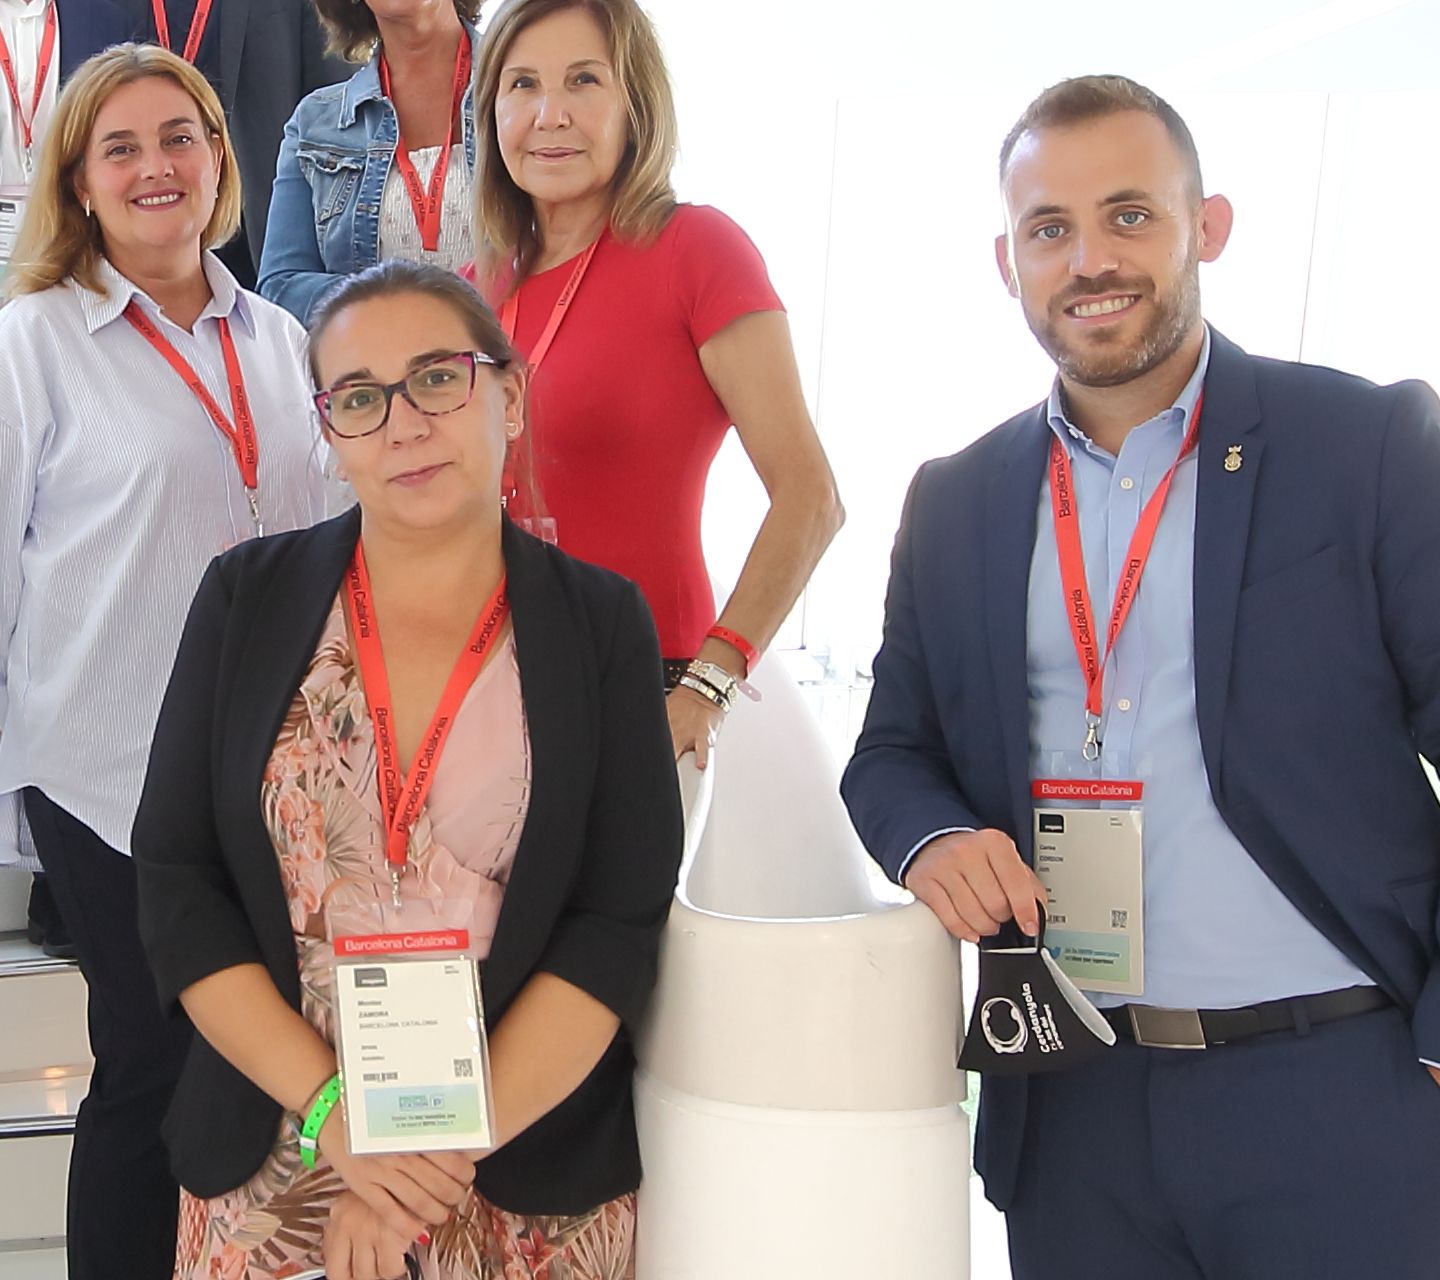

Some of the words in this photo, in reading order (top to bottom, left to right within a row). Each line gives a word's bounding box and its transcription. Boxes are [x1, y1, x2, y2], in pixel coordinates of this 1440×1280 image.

[242, 422, 255, 465] Barcelona
[1058, 459, 1071, 518] Barcelona
[350, 589, 370, 639] Catalonia
[1073, 589, 1092, 646] Catalonia
[1112, 559, 1141, 623] Barcelona
[471, 605, 500, 655] Barcelona
[375, 706, 395, 768] Barcelona
[396, 770, 427, 832] Barcelona
[418, 716, 449, 770] Catalonia
[1041, 783, 1090, 795] Barcelona
[1090, 784, 1133, 796] Catalonia
[344, 938, 403, 952] Barcelona
[403, 934, 457, 949] Catalonia
[1022, 982, 1050, 1053] Cerdanyola
